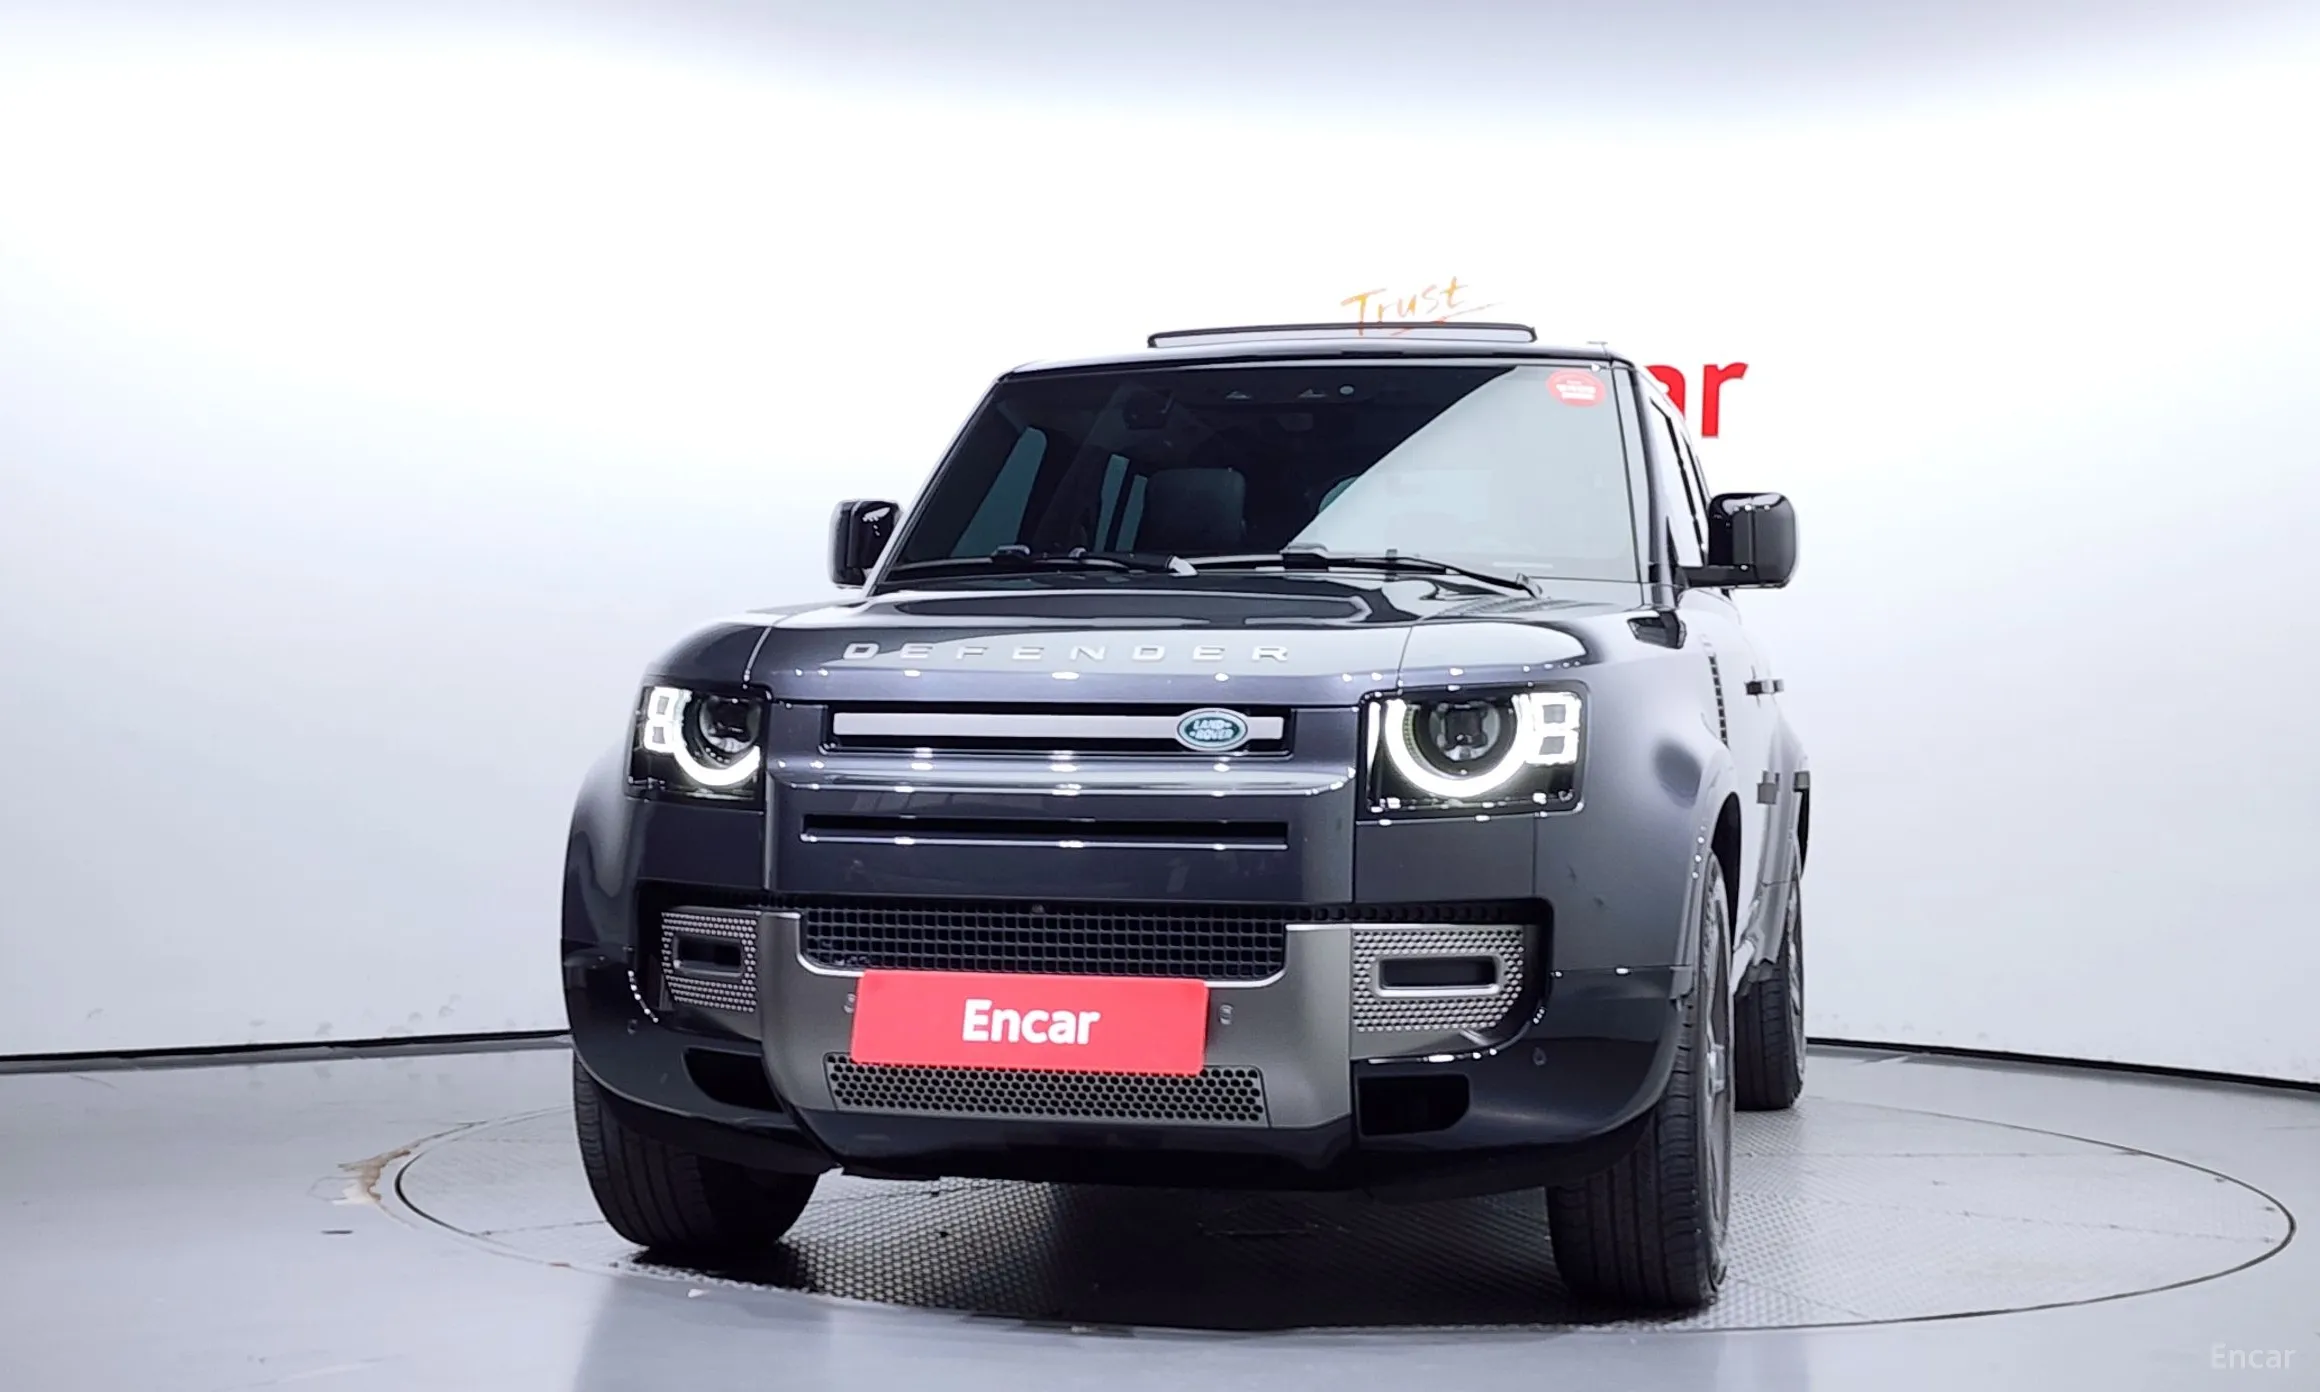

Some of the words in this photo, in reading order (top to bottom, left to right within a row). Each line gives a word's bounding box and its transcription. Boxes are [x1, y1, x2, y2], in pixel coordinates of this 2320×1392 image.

[1340, 276, 1468, 336] Trust
[842, 641, 1290, 662] DEFENDER
[1193, 719, 1227, 730] LAND
[961, 998, 1100, 1044] Encar
